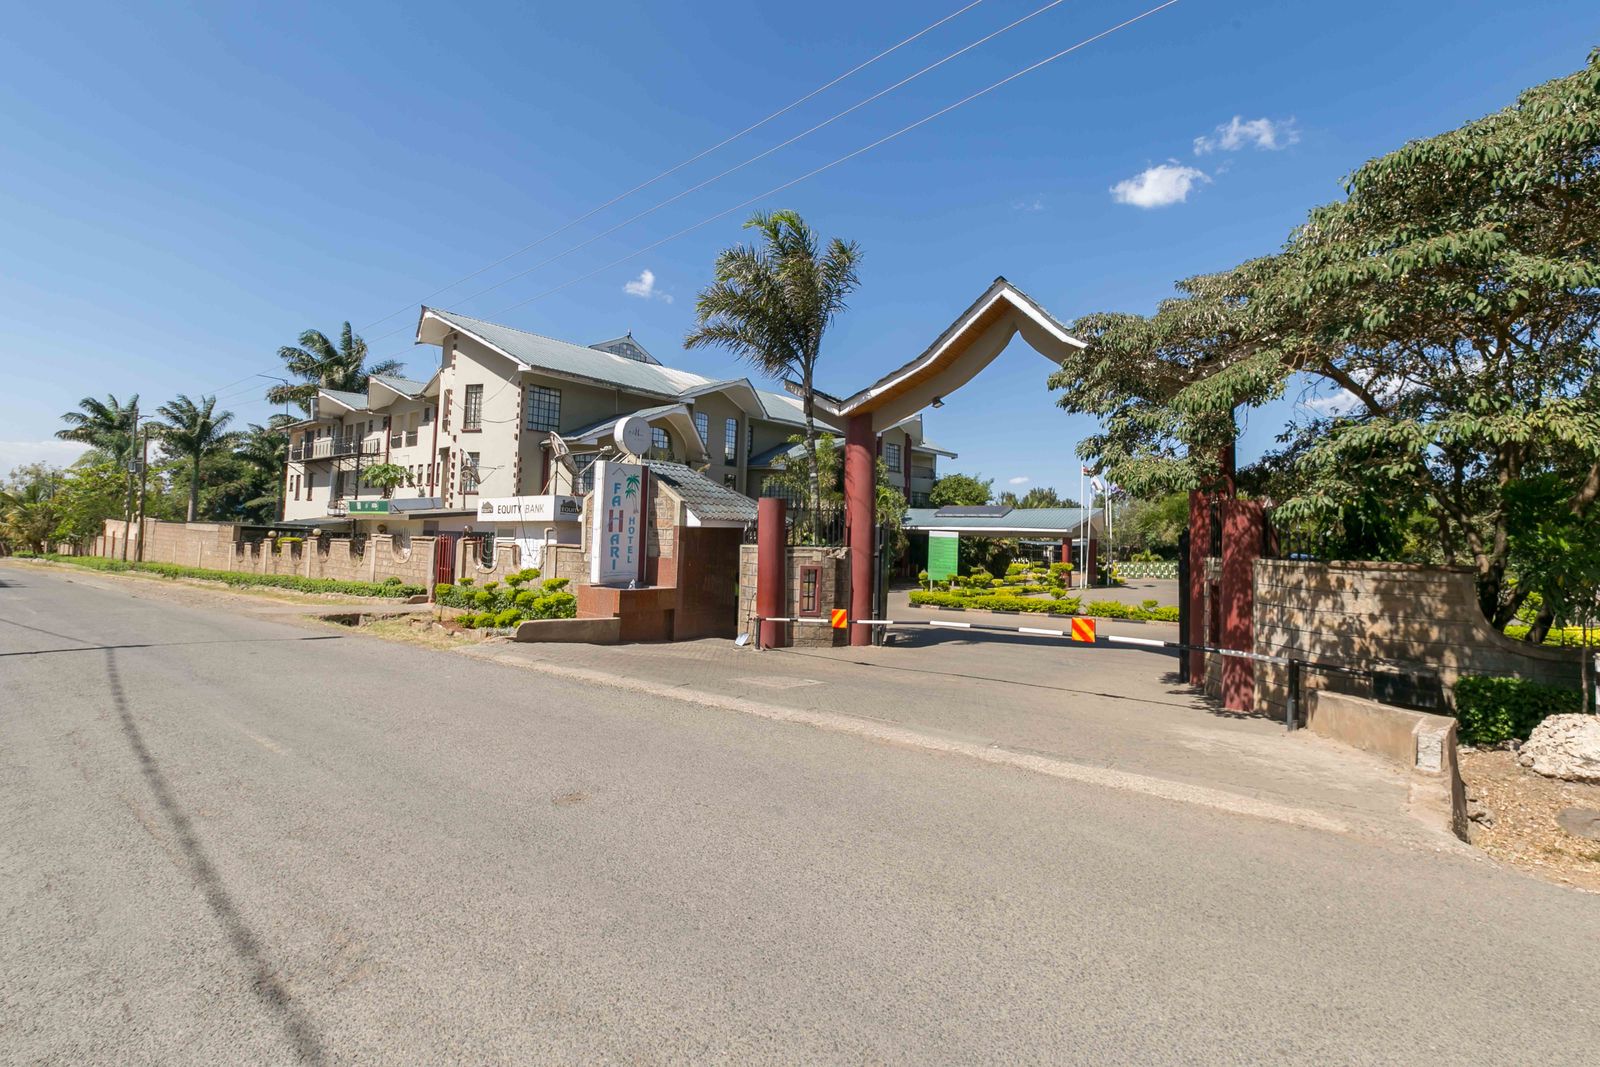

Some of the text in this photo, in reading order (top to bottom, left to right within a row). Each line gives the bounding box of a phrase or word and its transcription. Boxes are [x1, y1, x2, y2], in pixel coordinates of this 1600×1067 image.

[497, 504, 522, 514] EQUITY
[525, 504, 545, 514] BANK
[608, 483, 624, 570] FAHARI
[627, 517, 636, 563] HOTEL
